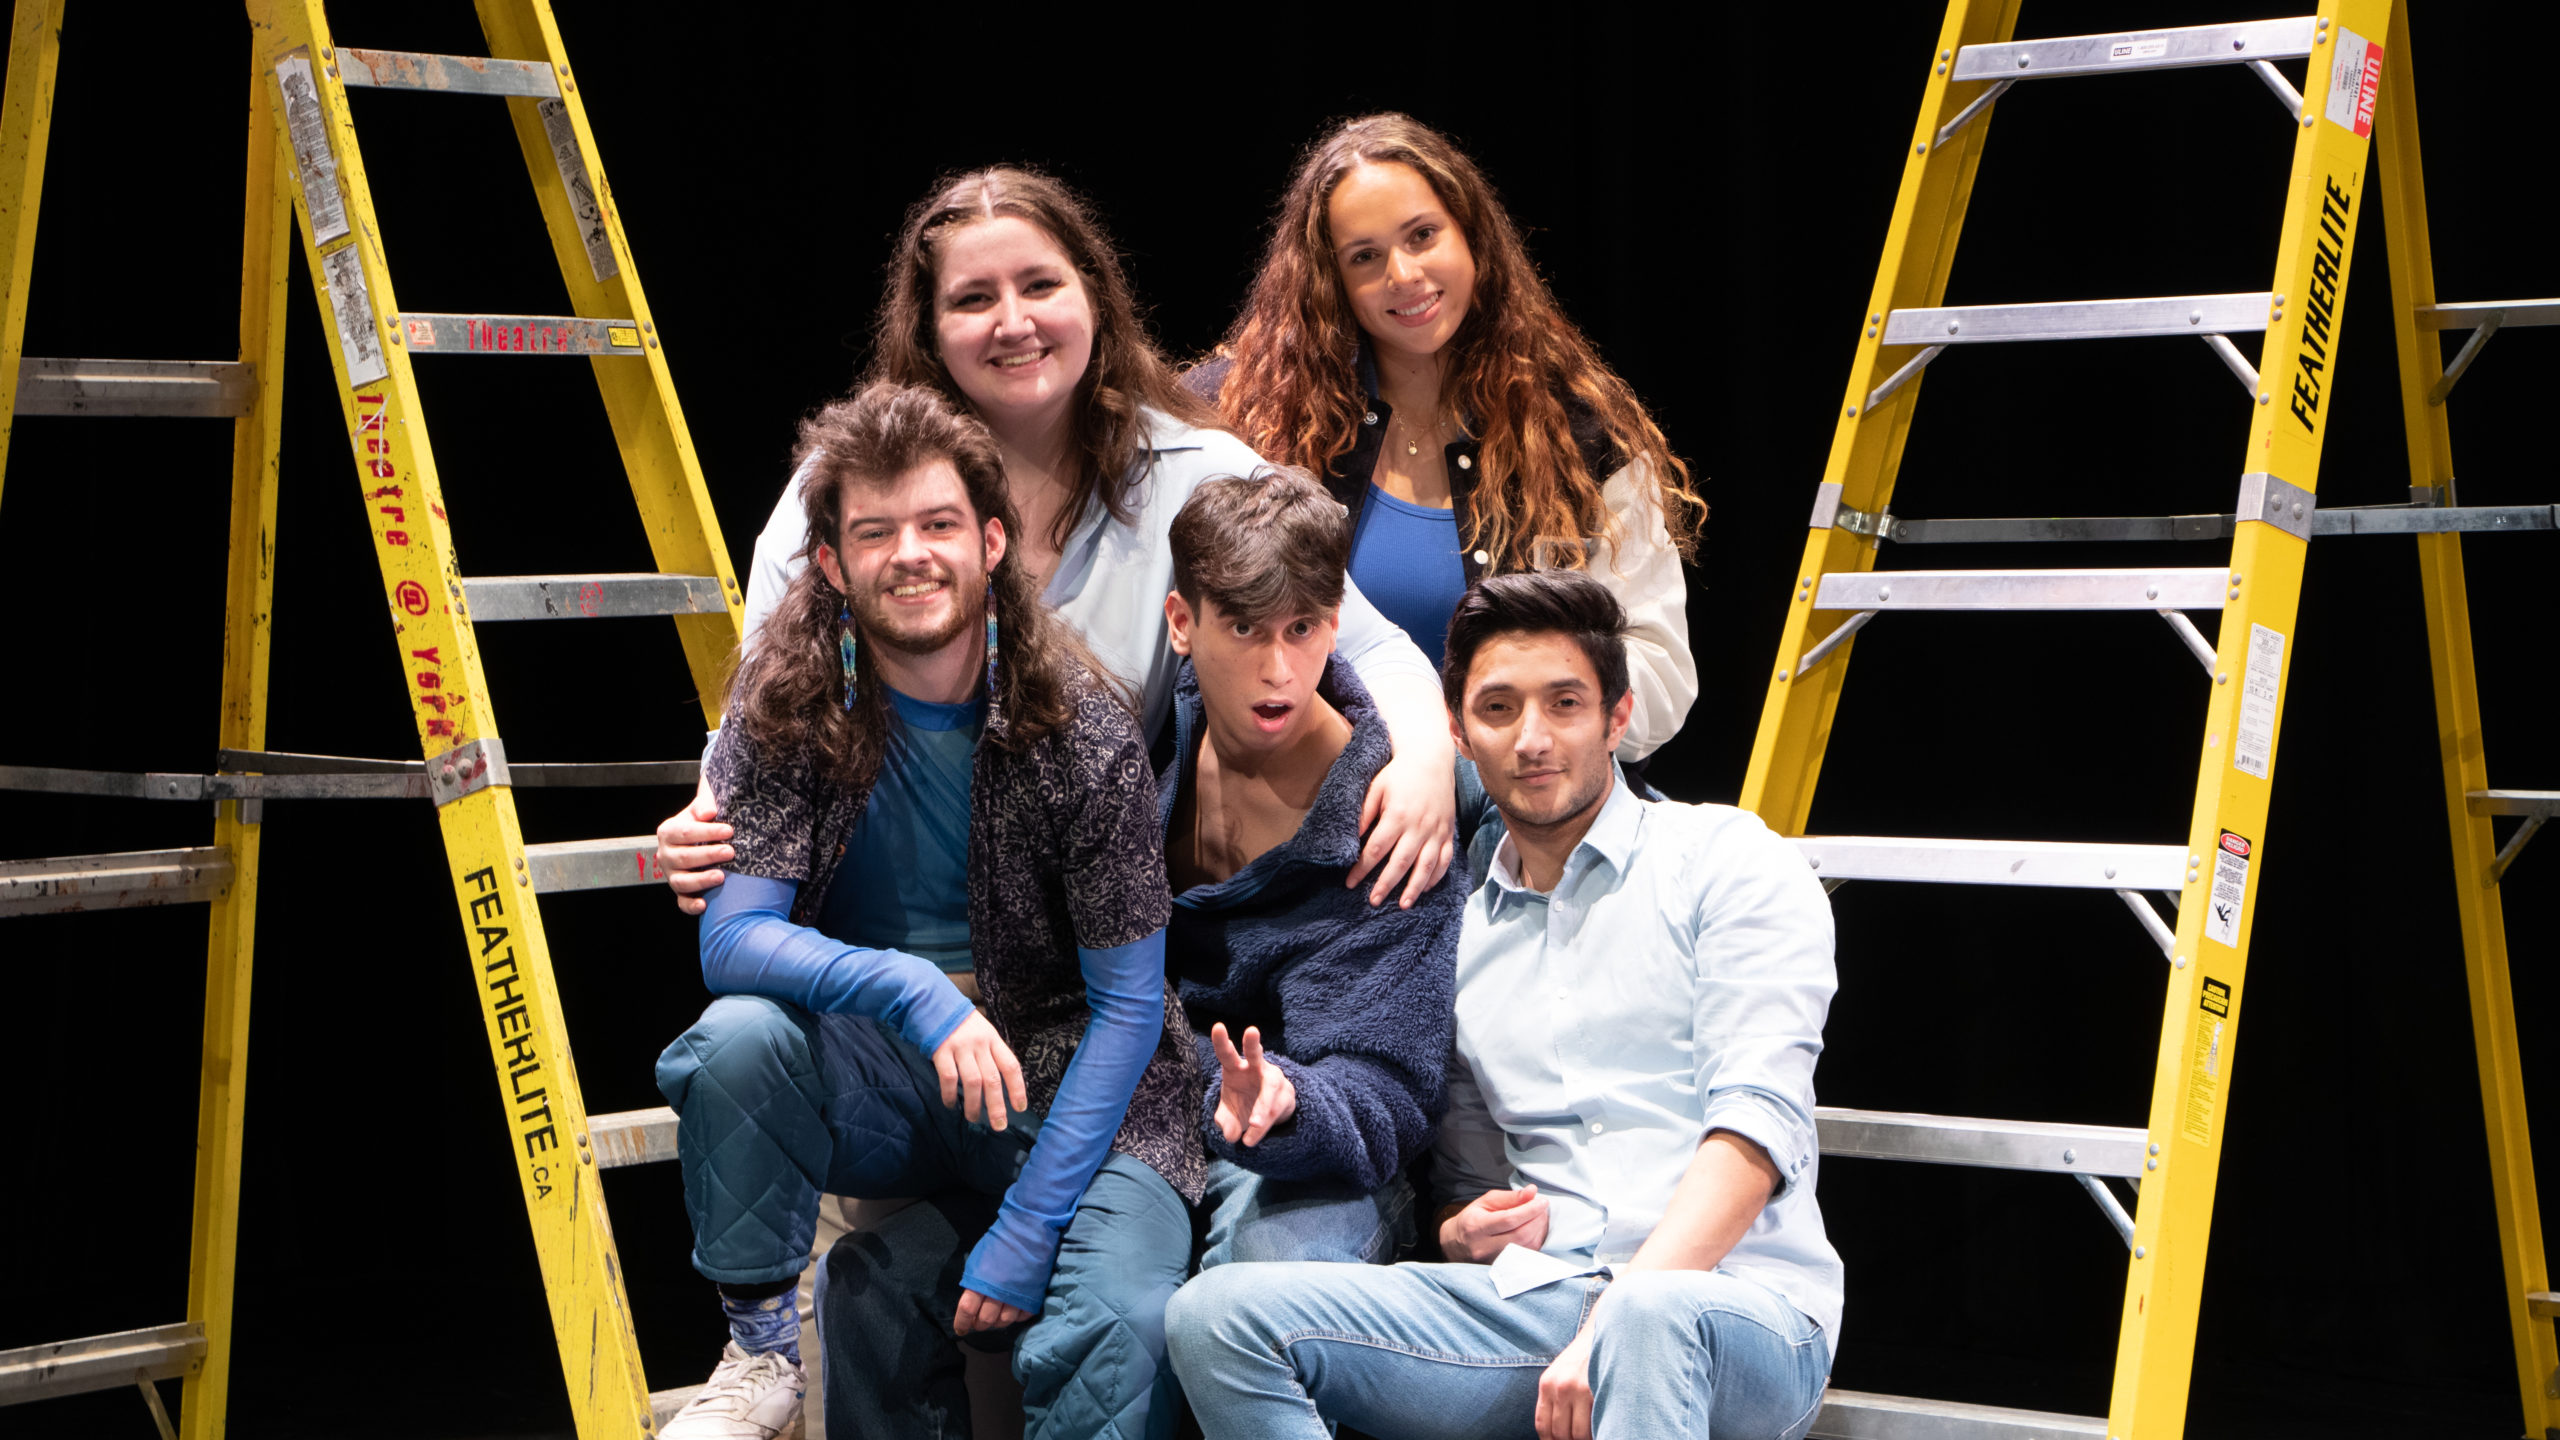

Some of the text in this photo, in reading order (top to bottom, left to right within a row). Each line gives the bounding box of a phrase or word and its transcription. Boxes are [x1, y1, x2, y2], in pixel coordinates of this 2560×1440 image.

[2357, 57, 2381, 126] ULINE
[466, 320, 568, 352] Theatre
[2291, 173, 2351, 435] FEATHERLITE
[357, 393, 409, 547] Theatre
[396, 580, 430, 616] @
[579, 582, 604, 617] @
